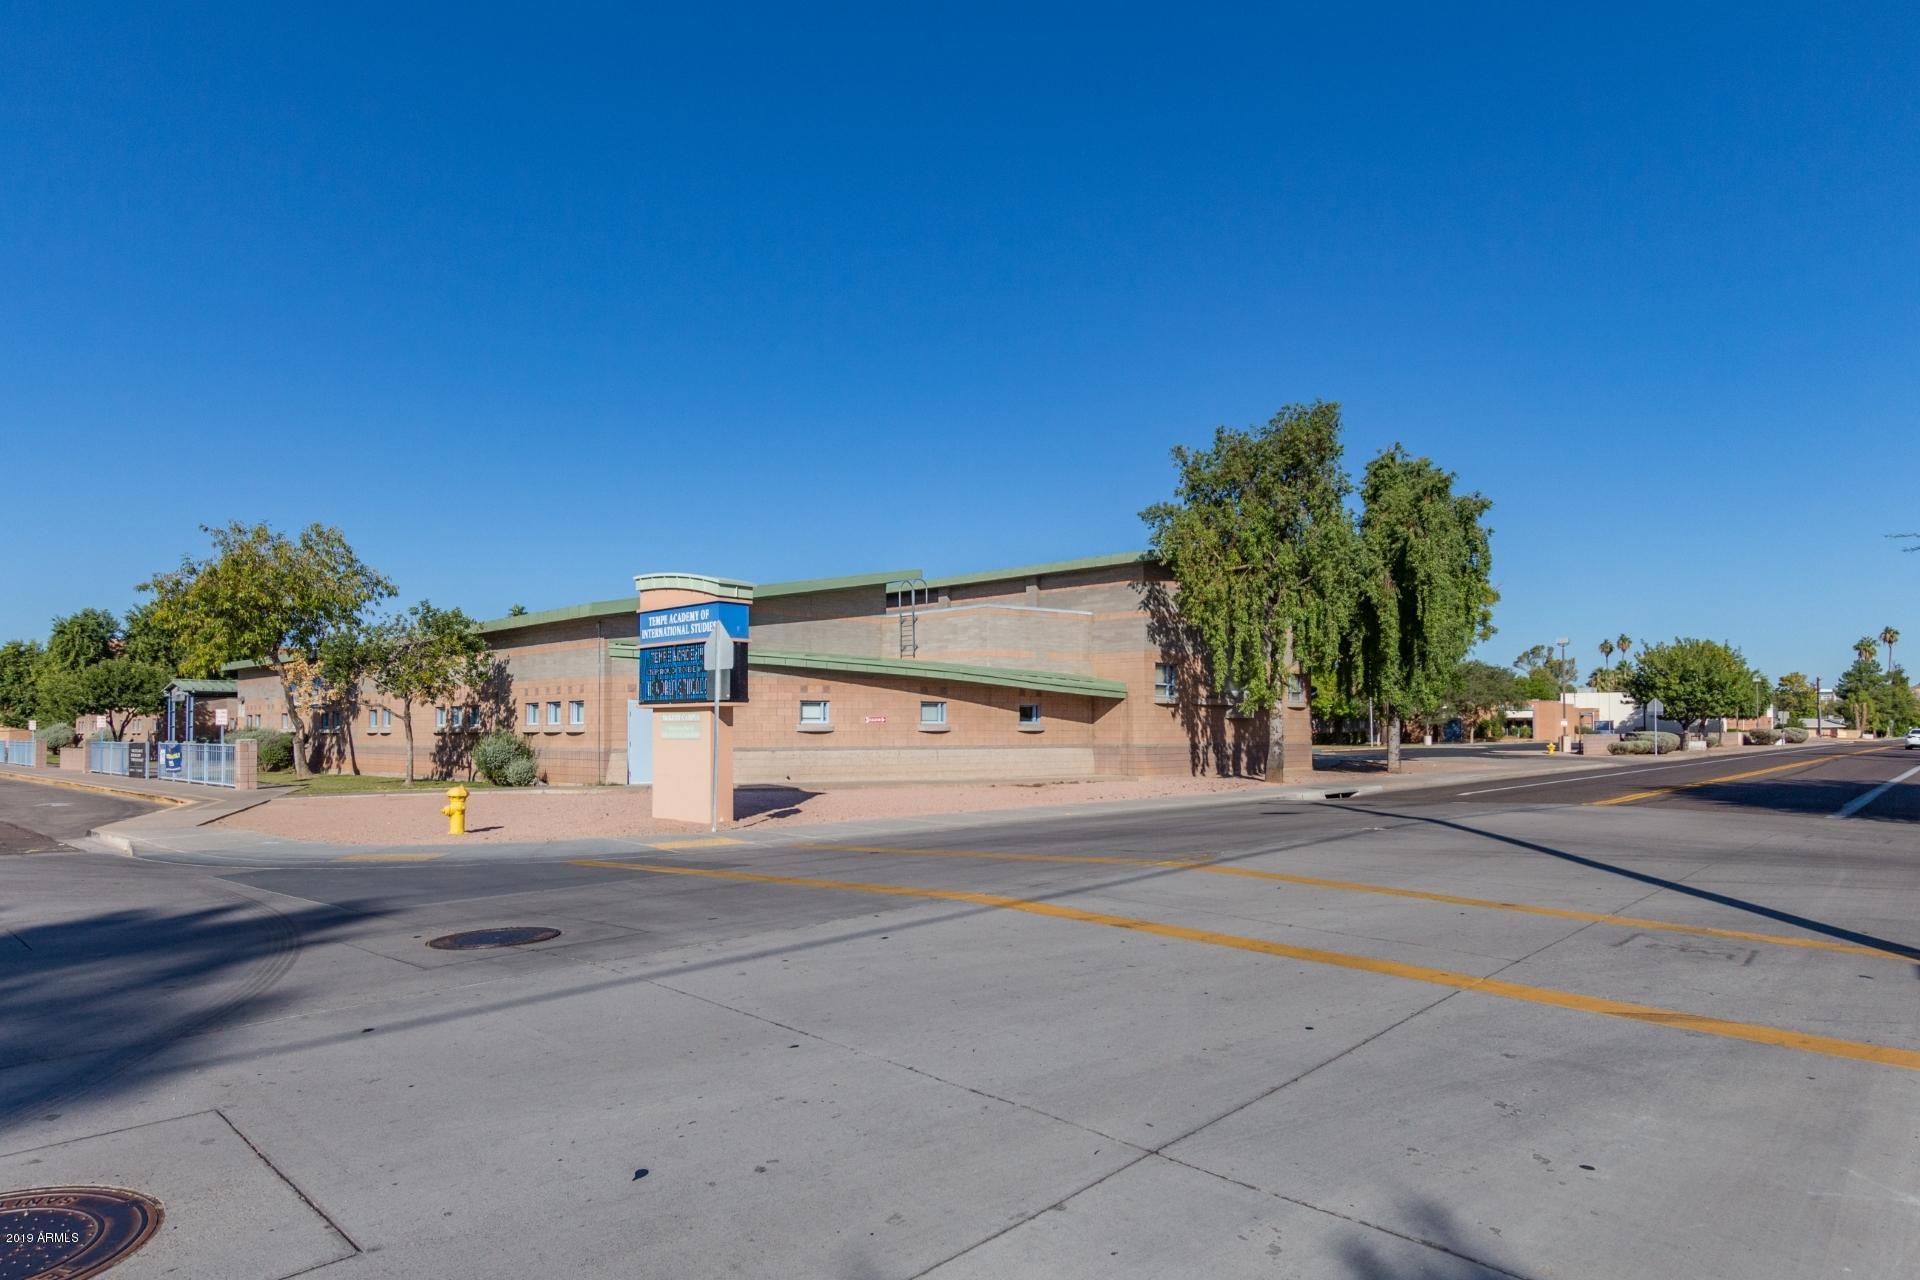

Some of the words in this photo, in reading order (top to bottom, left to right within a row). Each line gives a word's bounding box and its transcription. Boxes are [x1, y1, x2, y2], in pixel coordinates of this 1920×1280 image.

[649, 615, 668, 626] TEMPE
[669, 610, 700, 624] ACADEMY
[701, 609, 710, 620] OF
[642, 625, 689, 639] INTERNATIONAL
